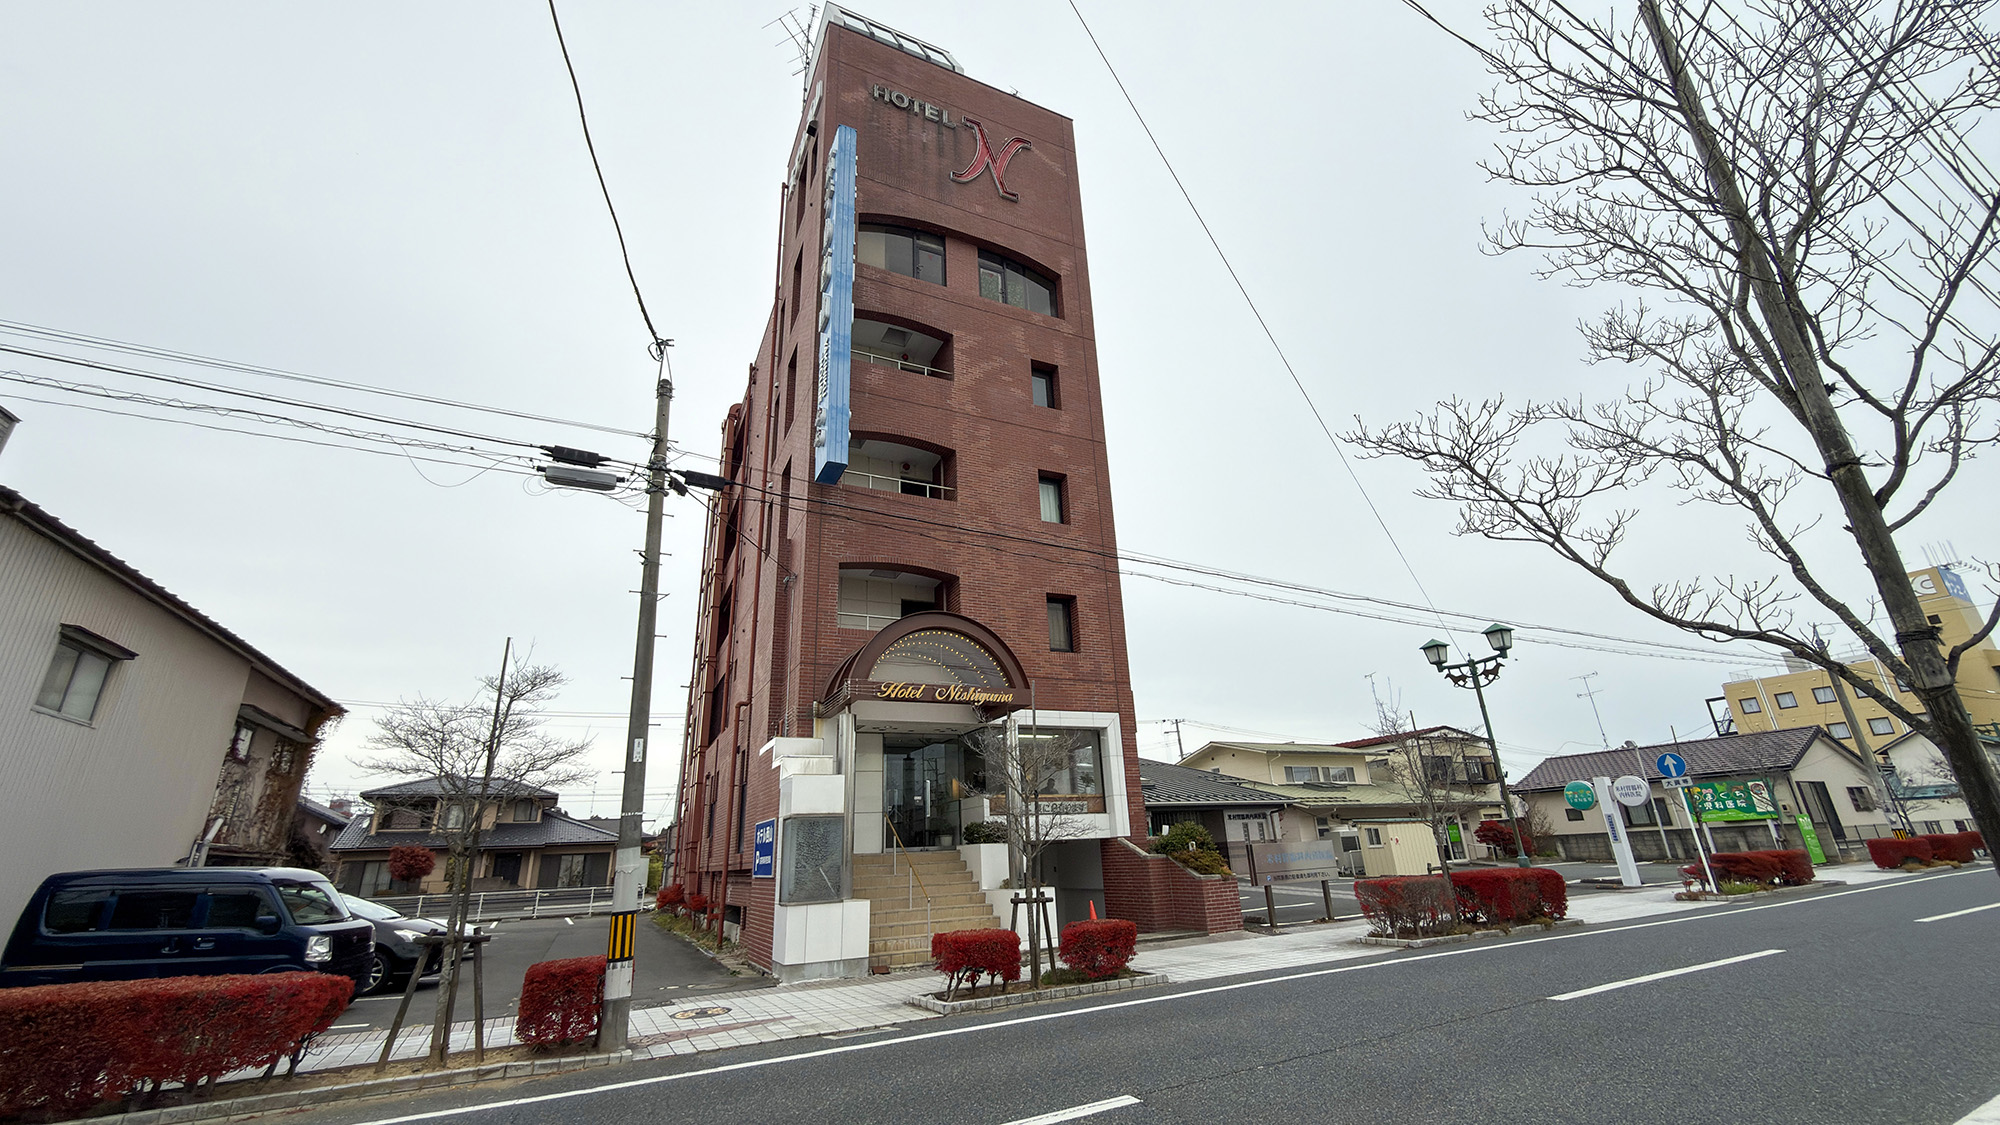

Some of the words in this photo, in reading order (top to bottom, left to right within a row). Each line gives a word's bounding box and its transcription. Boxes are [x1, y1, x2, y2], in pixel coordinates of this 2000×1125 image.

[871, 83, 957, 130] HOTEL
[950, 115, 1033, 203] N
[877, 680, 926, 699] Hotel
[935, 683, 1014, 706] Nishiyama
